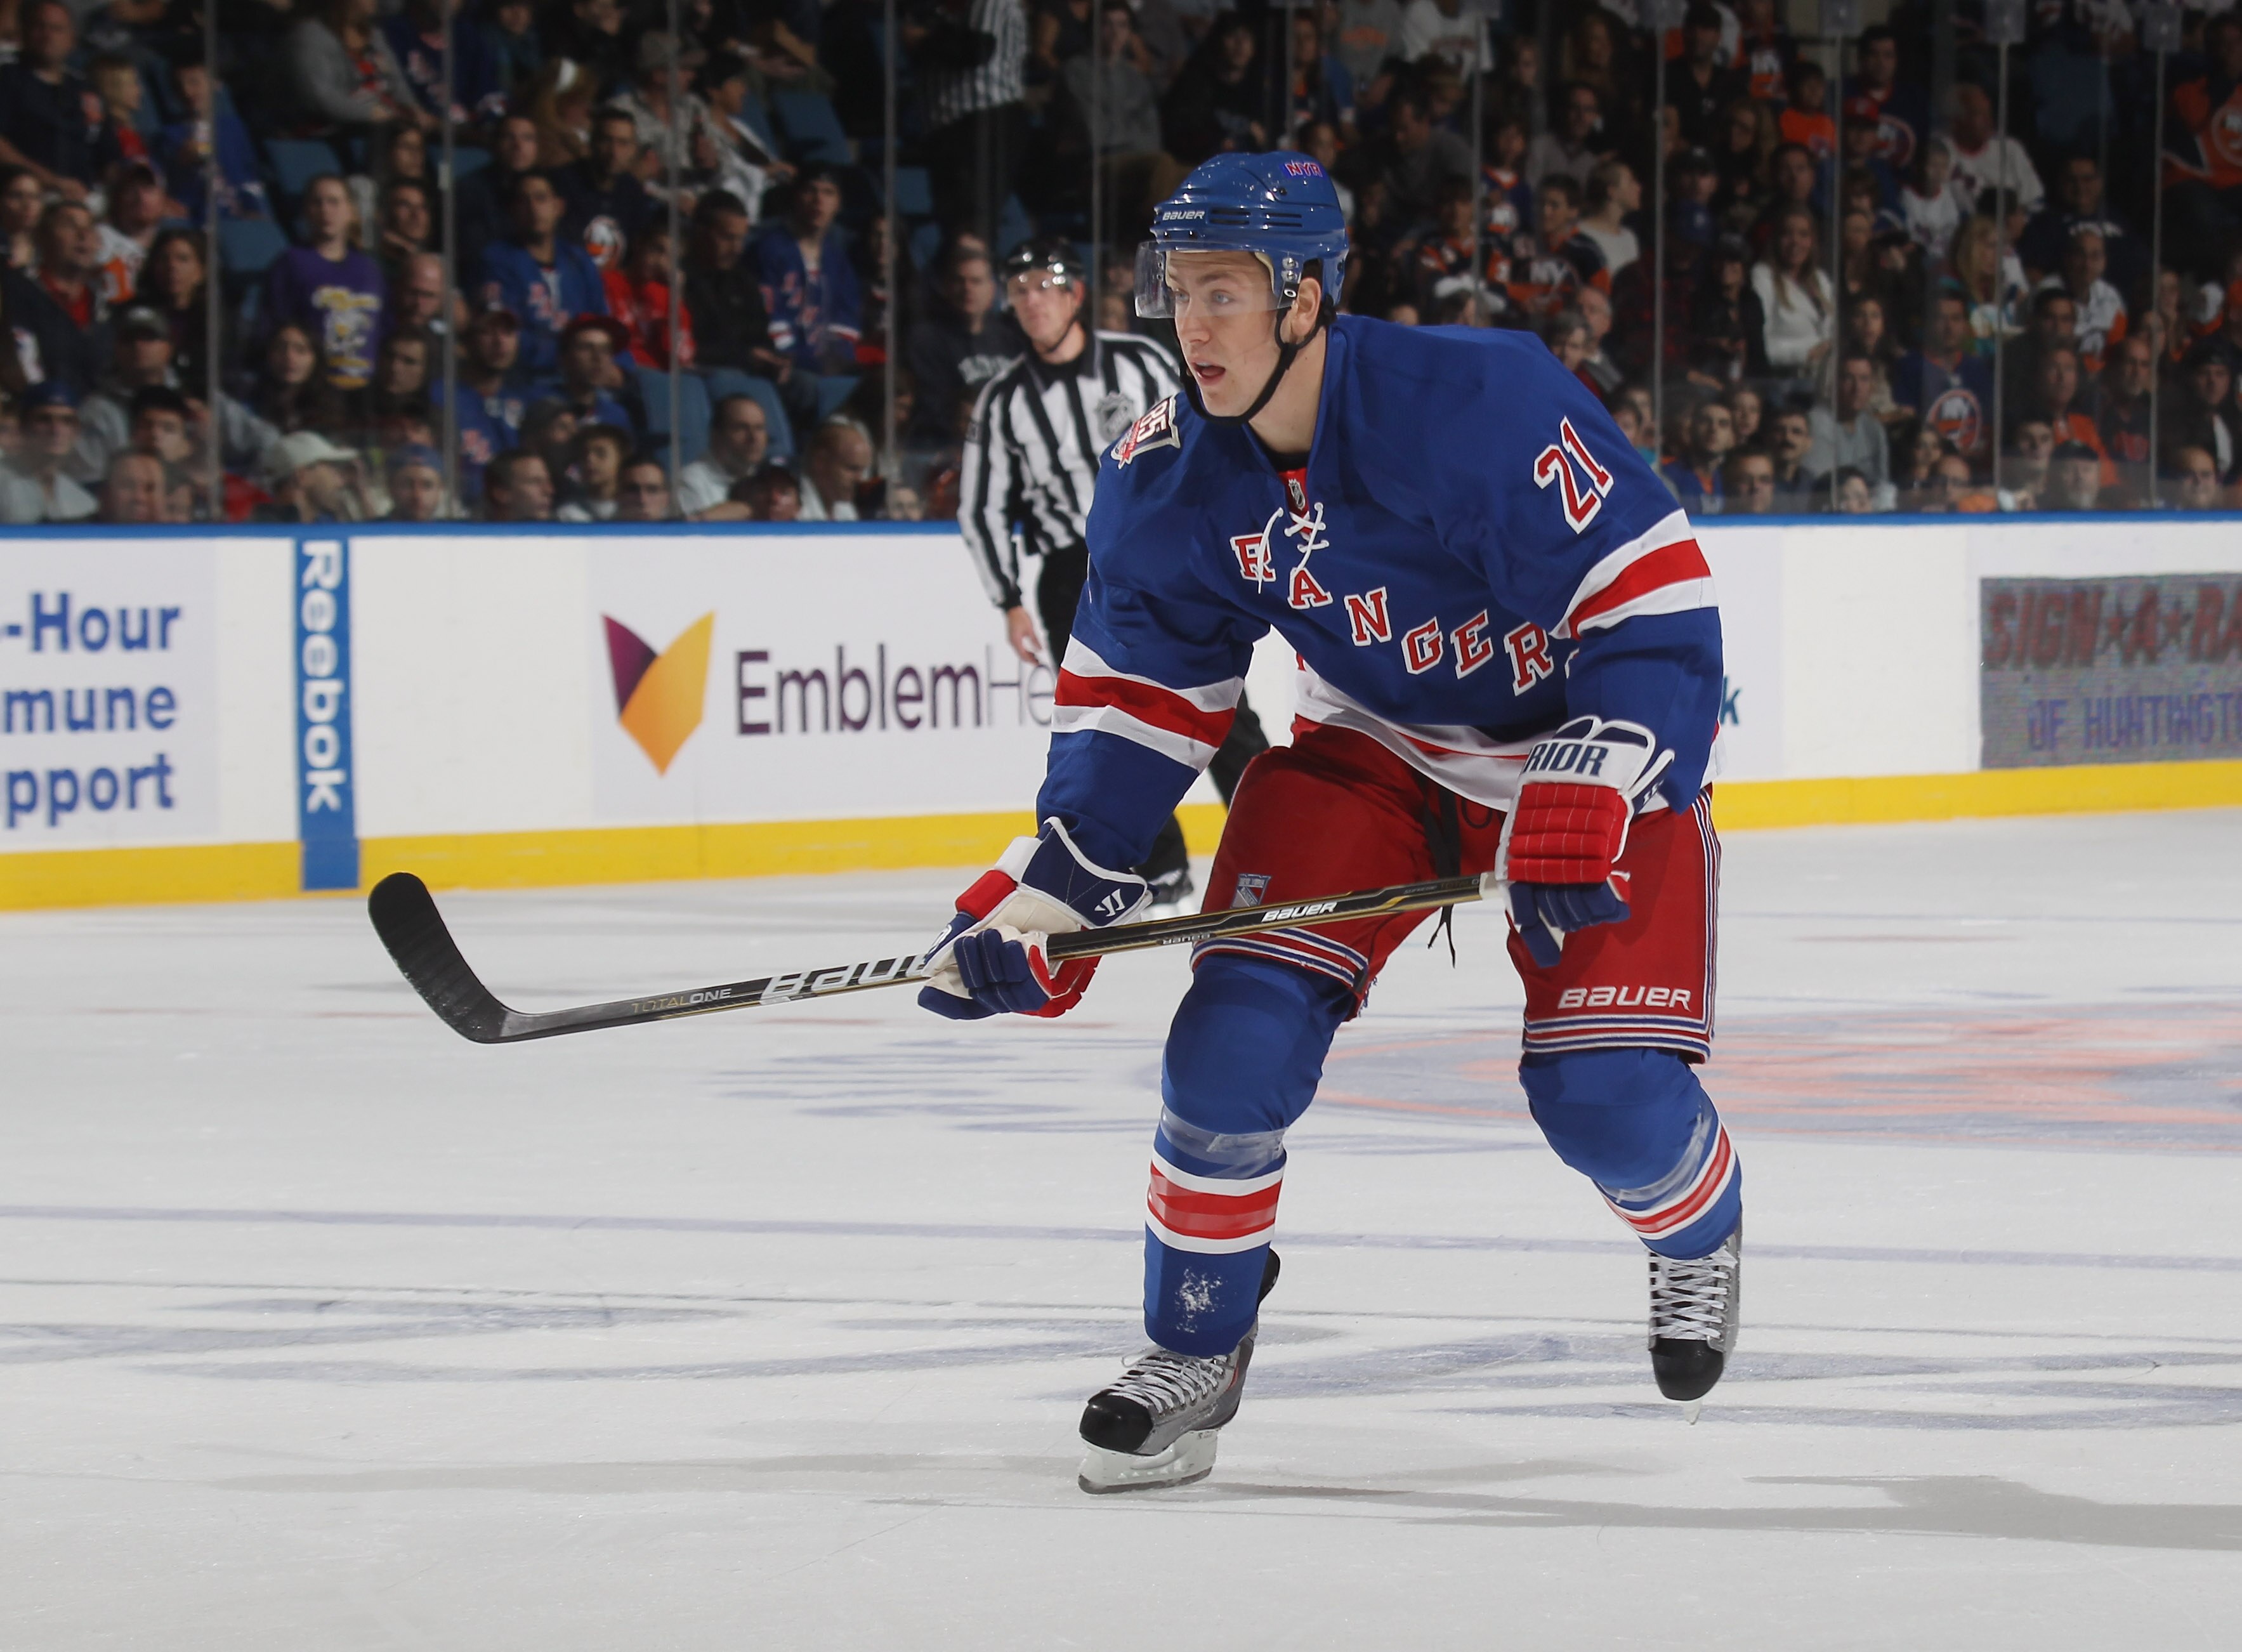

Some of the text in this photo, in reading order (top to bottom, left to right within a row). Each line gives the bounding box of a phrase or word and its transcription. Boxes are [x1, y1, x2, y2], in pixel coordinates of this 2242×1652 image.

[1284, 161, 1323, 178] NYR
[1162, 210, 1205, 221] BAUER
[1533, 416, 1614, 534] 21
[1229, 532, 1580, 697] RANGER
[301, 539, 347, 813] Reebok
[3, 685, 177, 734] mune
[2083, 692, 2242, 749] HUNTINGT
[1261, 901, 1338, 923] BAUER
[1557, 985, 1693, 1013] BAUER
